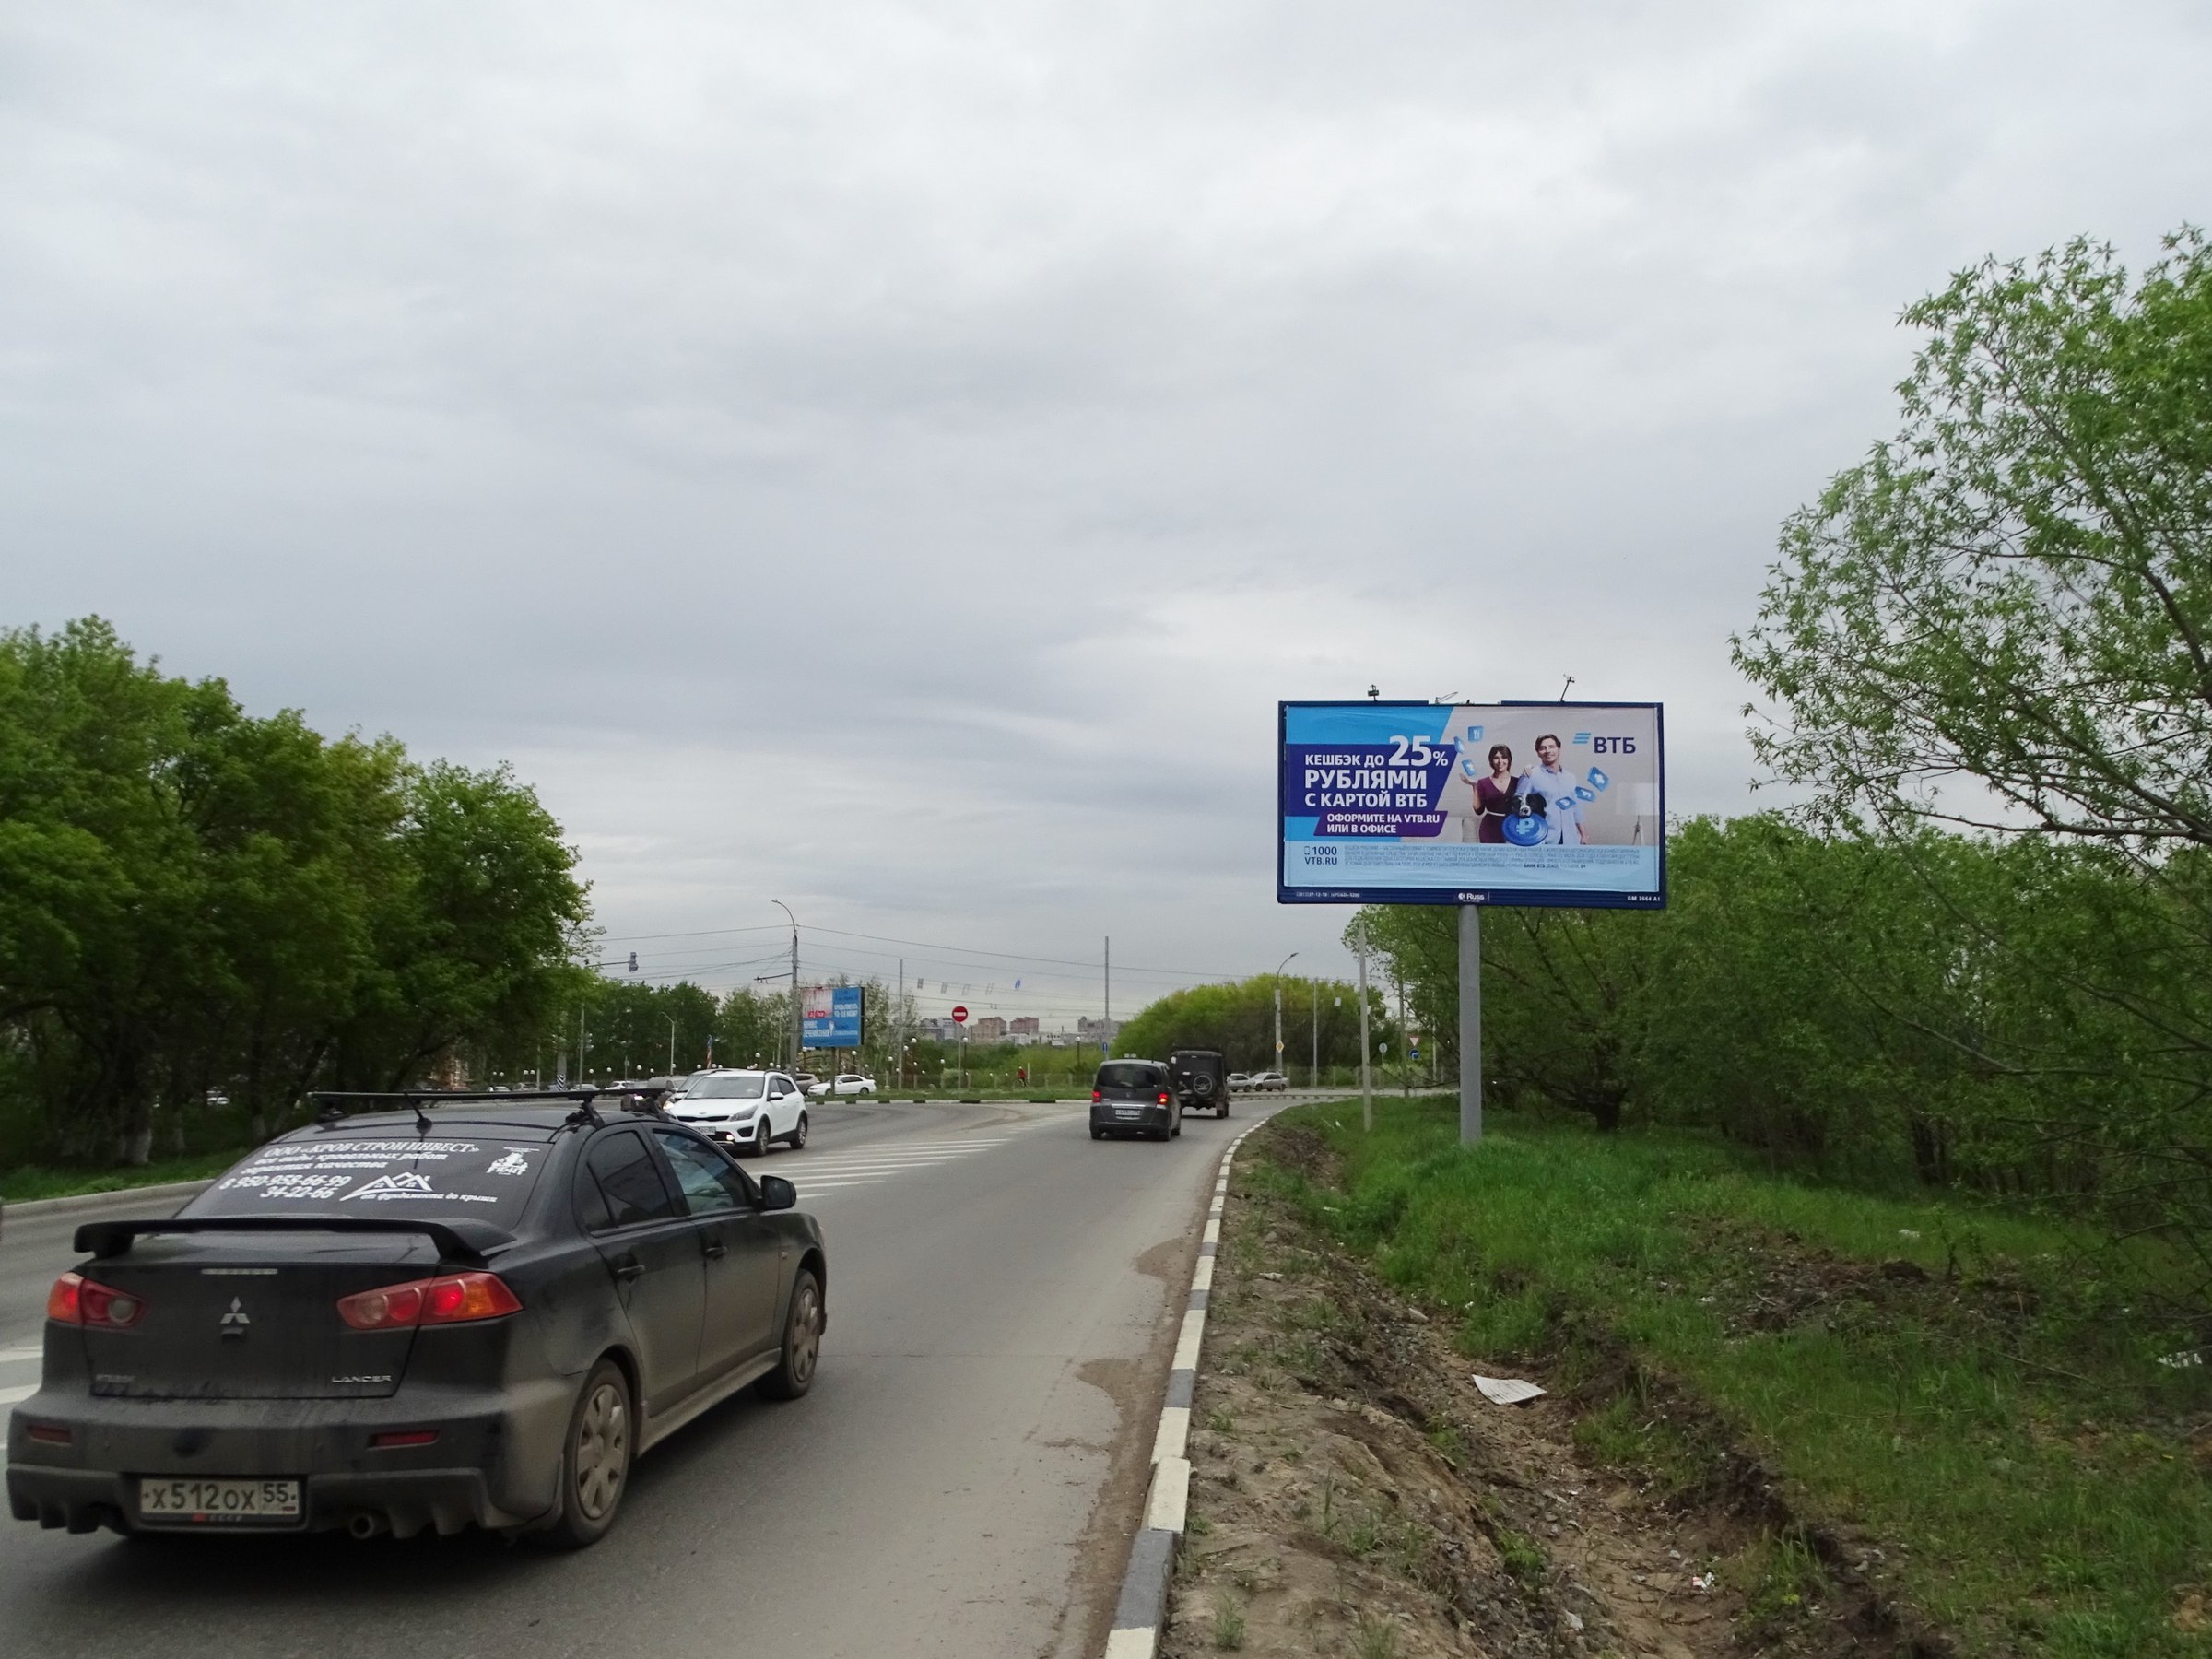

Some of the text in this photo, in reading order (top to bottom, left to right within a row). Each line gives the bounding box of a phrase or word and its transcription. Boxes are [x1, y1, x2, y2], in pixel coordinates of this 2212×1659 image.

[1594, 736, 1636, 754] ВТБ
[1305, 754, 1361, 766] КЕШБЭК
[1364, 754, 1385, 768] ДО
[1305, 769, 1427, 790] РУБЛЯМИ
[1305, 790, 1428, 807] С КАРТОЙ ВТБ
[1326, 813, 1440, 824] ОФОРМИТЕ НА VTB.RU
[1326, 824, 1397, 834] ИЛИ В ОФИСЕ
[1312, 846, 1337, 855] 1000
[1304, 856, 1338, 865] VTB.RU
[264, 1146, 302, 1158] ООО
